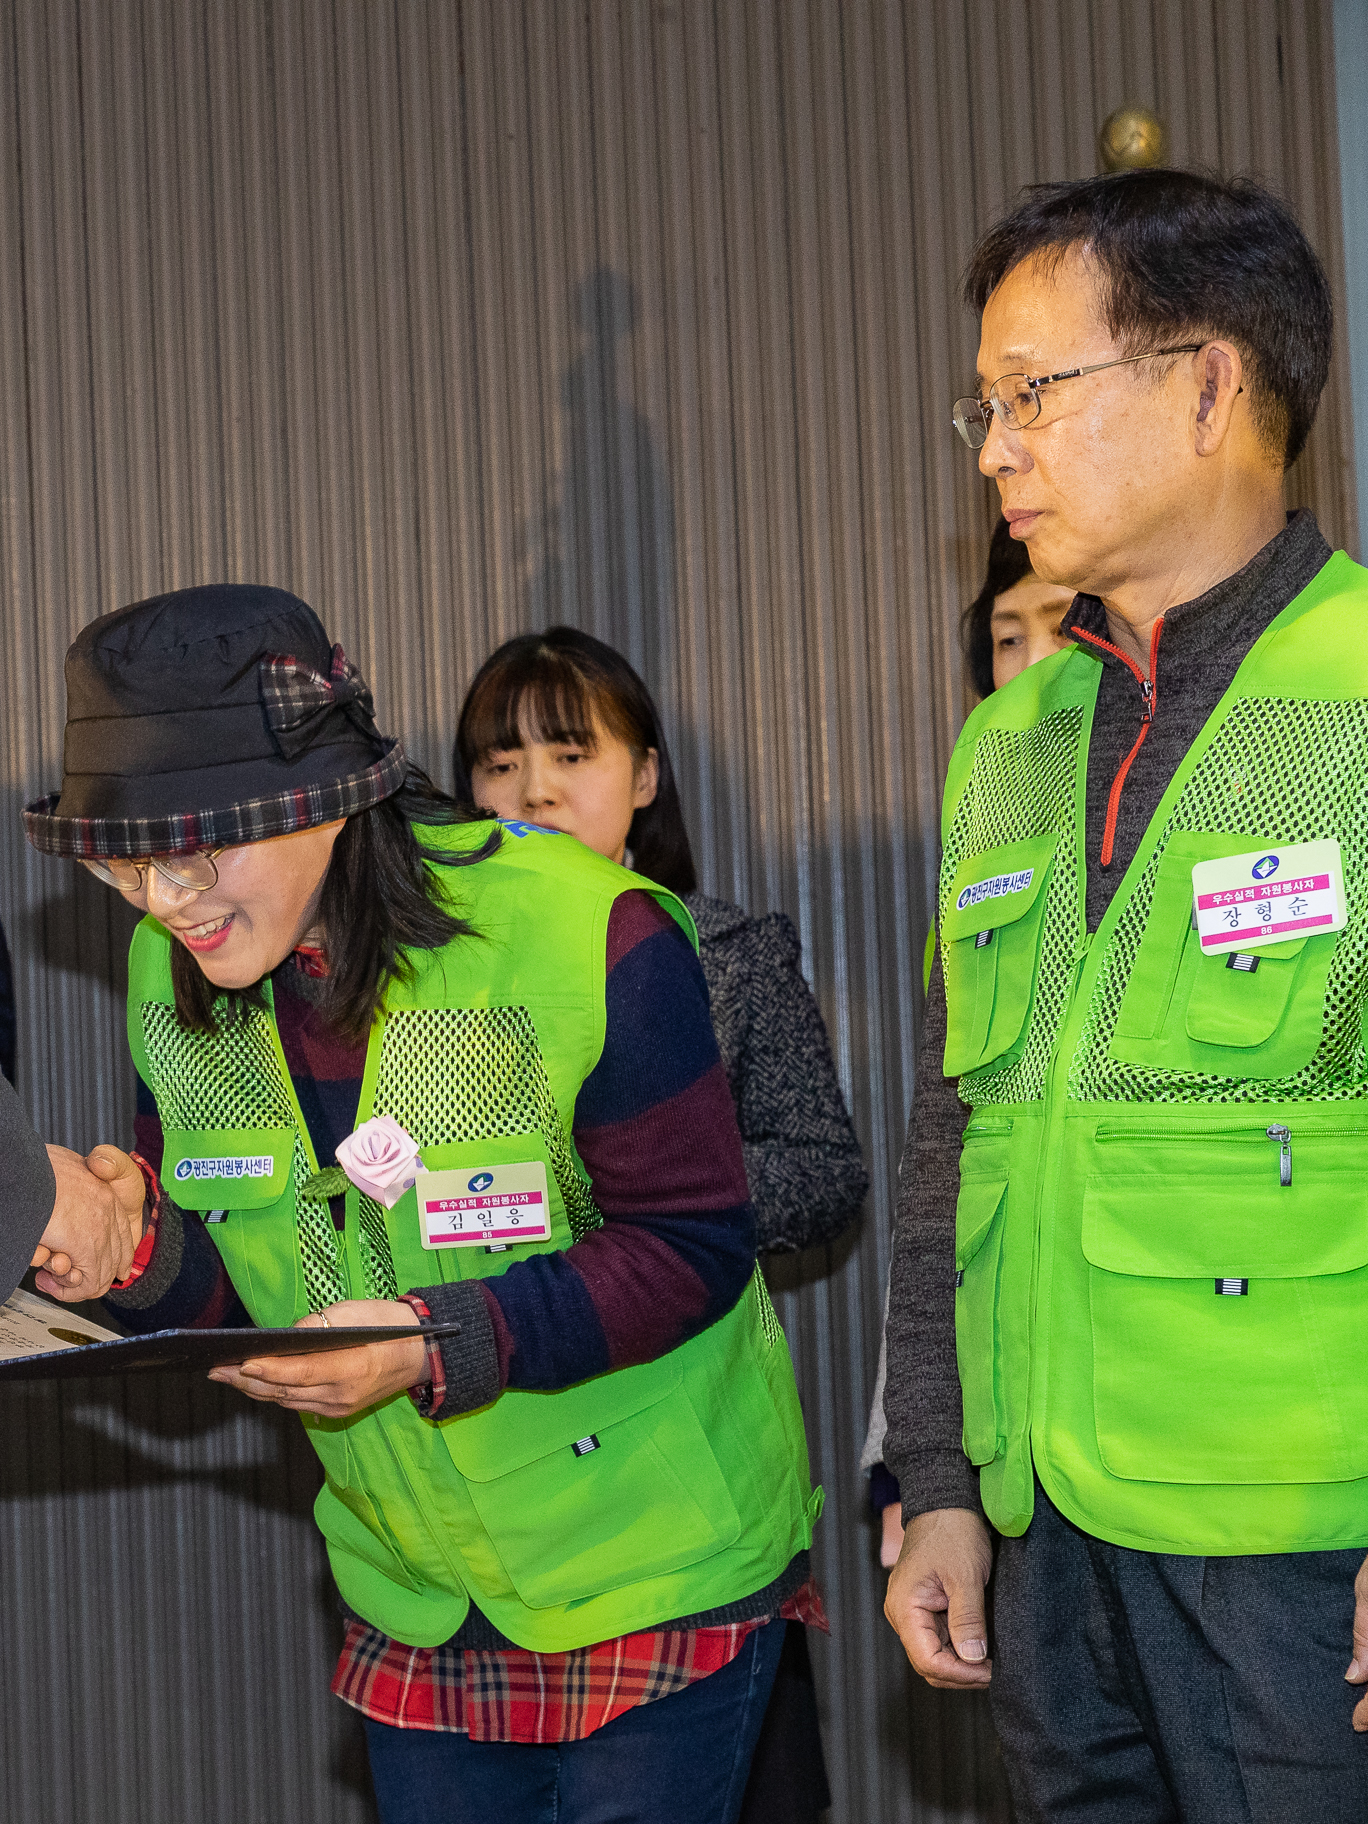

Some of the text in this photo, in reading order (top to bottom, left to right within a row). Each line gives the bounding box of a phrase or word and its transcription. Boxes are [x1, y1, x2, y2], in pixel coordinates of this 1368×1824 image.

[970, 870, 1033, 904] 광진구자원봉사센터
[1212, 879, 1314, 905] 우수실적 자원봉사자
[1260, 925, 1273, 935] 86
[192, 1158, 272, 1177] 광진구자원봉사센터
[439, 1194, 529, 1211] 우수실적 자원봉사자
[481, 1231, 493, 1239] 85
